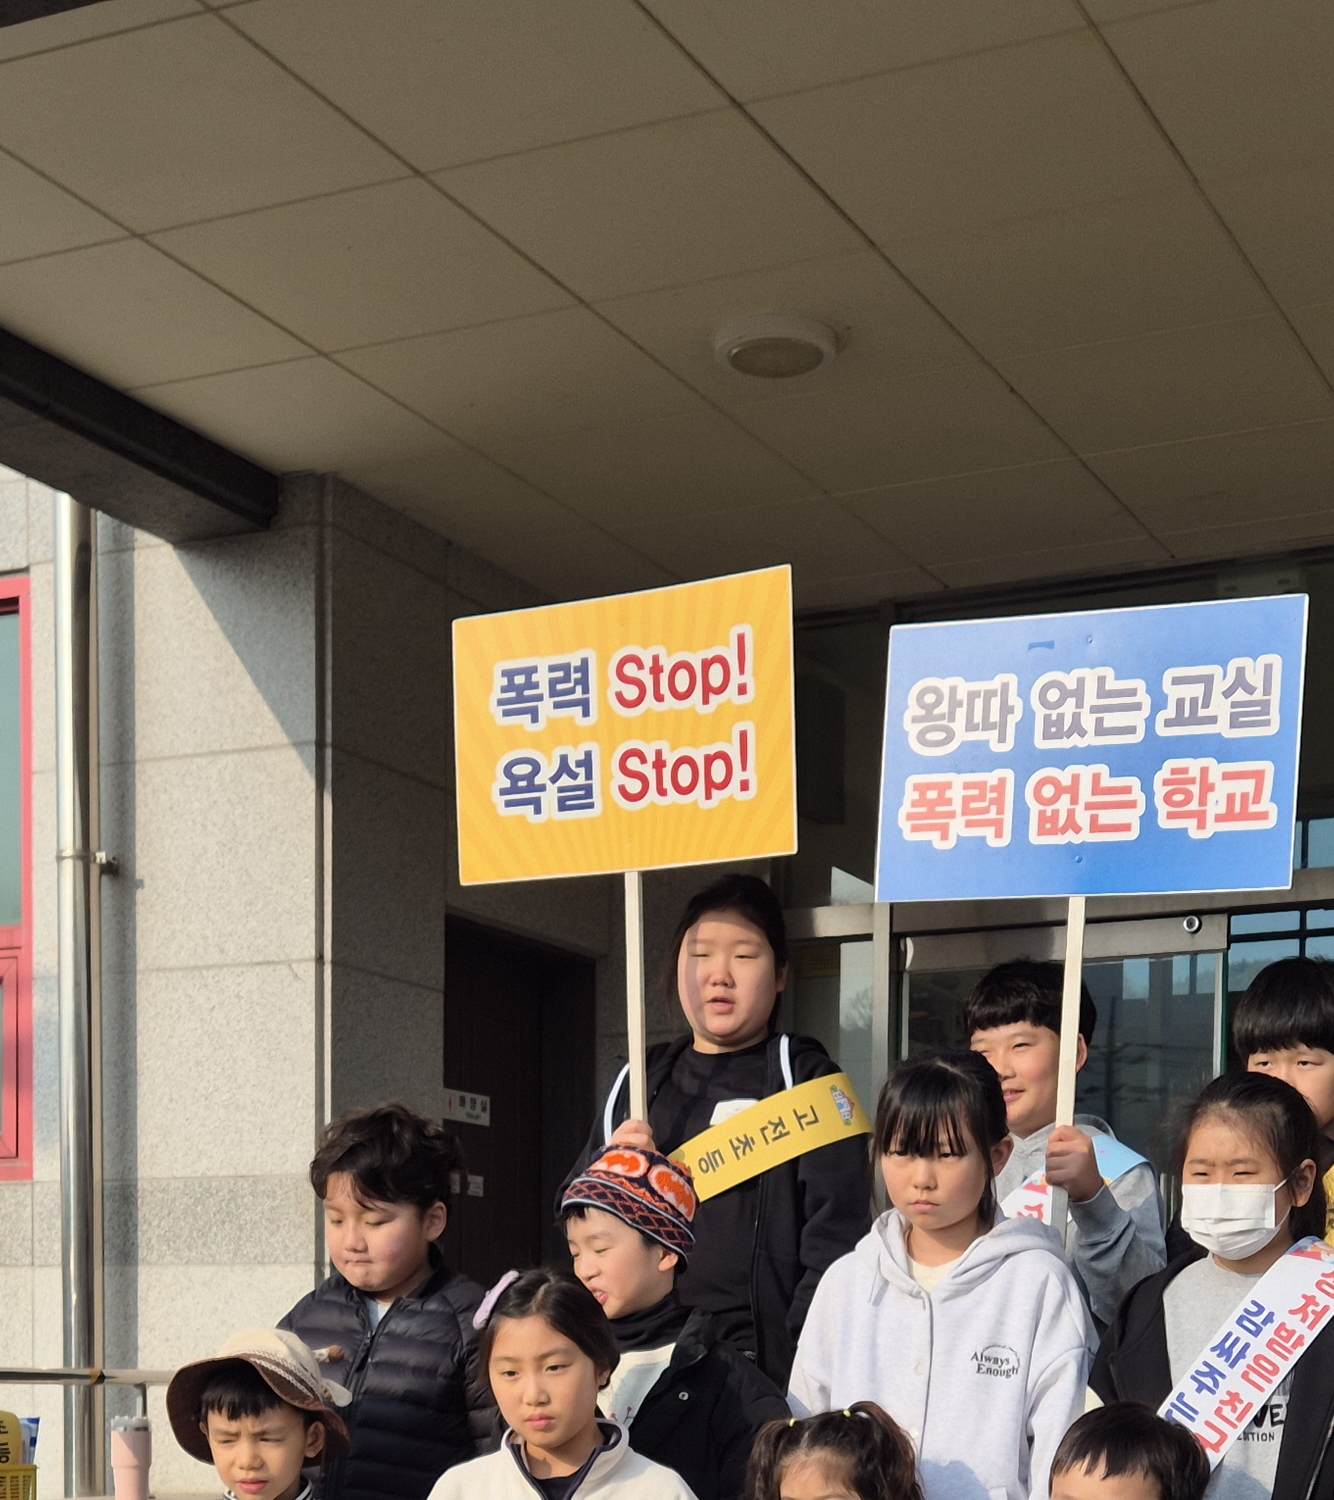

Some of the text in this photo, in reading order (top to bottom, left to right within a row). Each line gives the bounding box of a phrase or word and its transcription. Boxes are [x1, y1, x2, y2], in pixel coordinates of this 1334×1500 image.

[495, 631, 749, 725] 폭력 Stop!
[910, 661, 1279, 751] 왕따 없는 교실
[498, 728, 752, 817] 욕설 Stop!
[904, 764, 1272, 843] 폭력 없는 학교
[970, 1351, 1010, 1368] Always
[975, 1362, 1019, 1379] Enough
